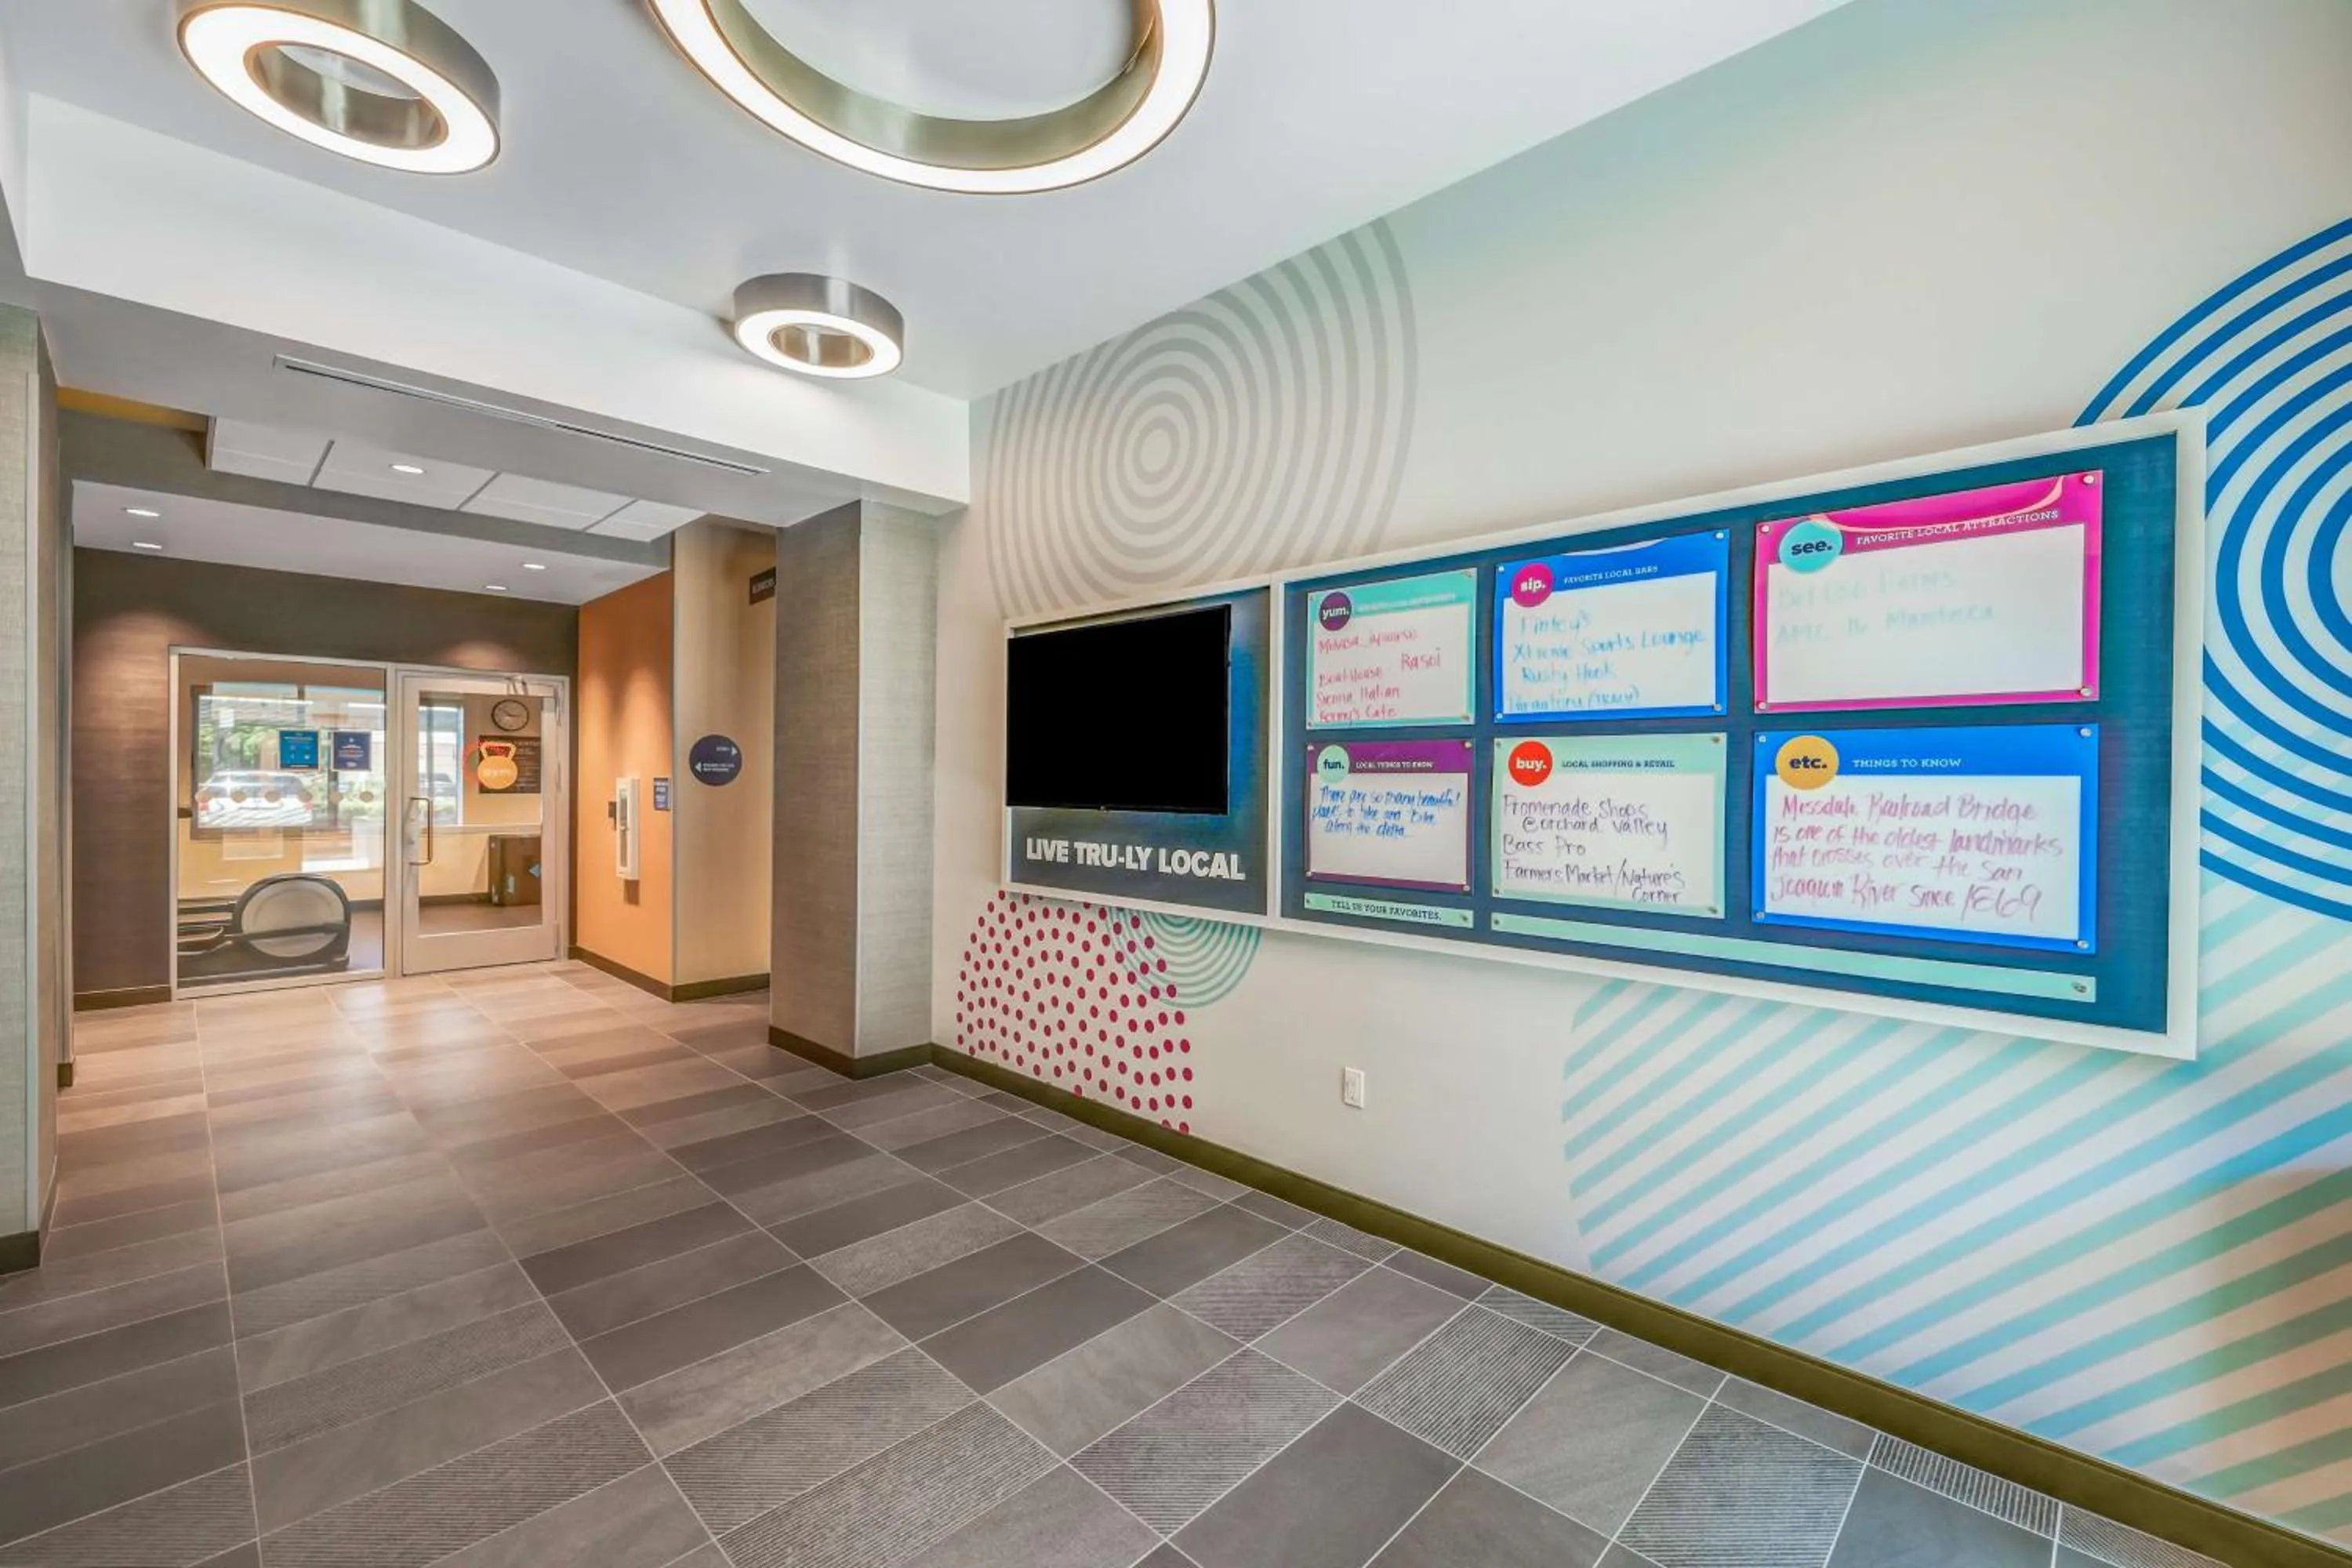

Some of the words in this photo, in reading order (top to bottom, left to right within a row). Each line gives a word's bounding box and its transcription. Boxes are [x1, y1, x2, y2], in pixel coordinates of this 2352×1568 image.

[1856, 529, 1914, 545] FAVORITE
[1917, 523, 1960, 535] LOCAL
[1962, 510, 2059, 531] ATTRACTIONS
[1791, 540, 1833, 556] see.
[1605, 569, 1632, 579] LOCAL
[1520, 576, 1547, 593] sip.
[1323, 607, 1349, 620] yum.
[1323, 759, 1345, 769] fun.
[1516, 757, 1547, 771] buy.
[1562, 760, 1588, 768] LOCAL
[1591, 760, 1633, 768] SHOPPING
[1644, 760, 1675, 768] RETAIL
[1789, 756, 1828, 769] etc.
[1853, 758, 1898, 768] THINGS
[1900, 758, 1918, 768] TO
[1922, 758, 1962, 768] KNOW
[1503, 794, 1592, 817] Promenade
[1958, 793, 2038, 834] Bridge
[1503, 834, 1544, 855] Bass
[1555, 836, 1586, 857] Pro
[1026, 837, 1069, 863] LIVE
[1073, 840, 1153, 871] TRU-LY
[1158, 848, 1246, 880] LOCAL
[1331, 900, 1351, 910] TELL
